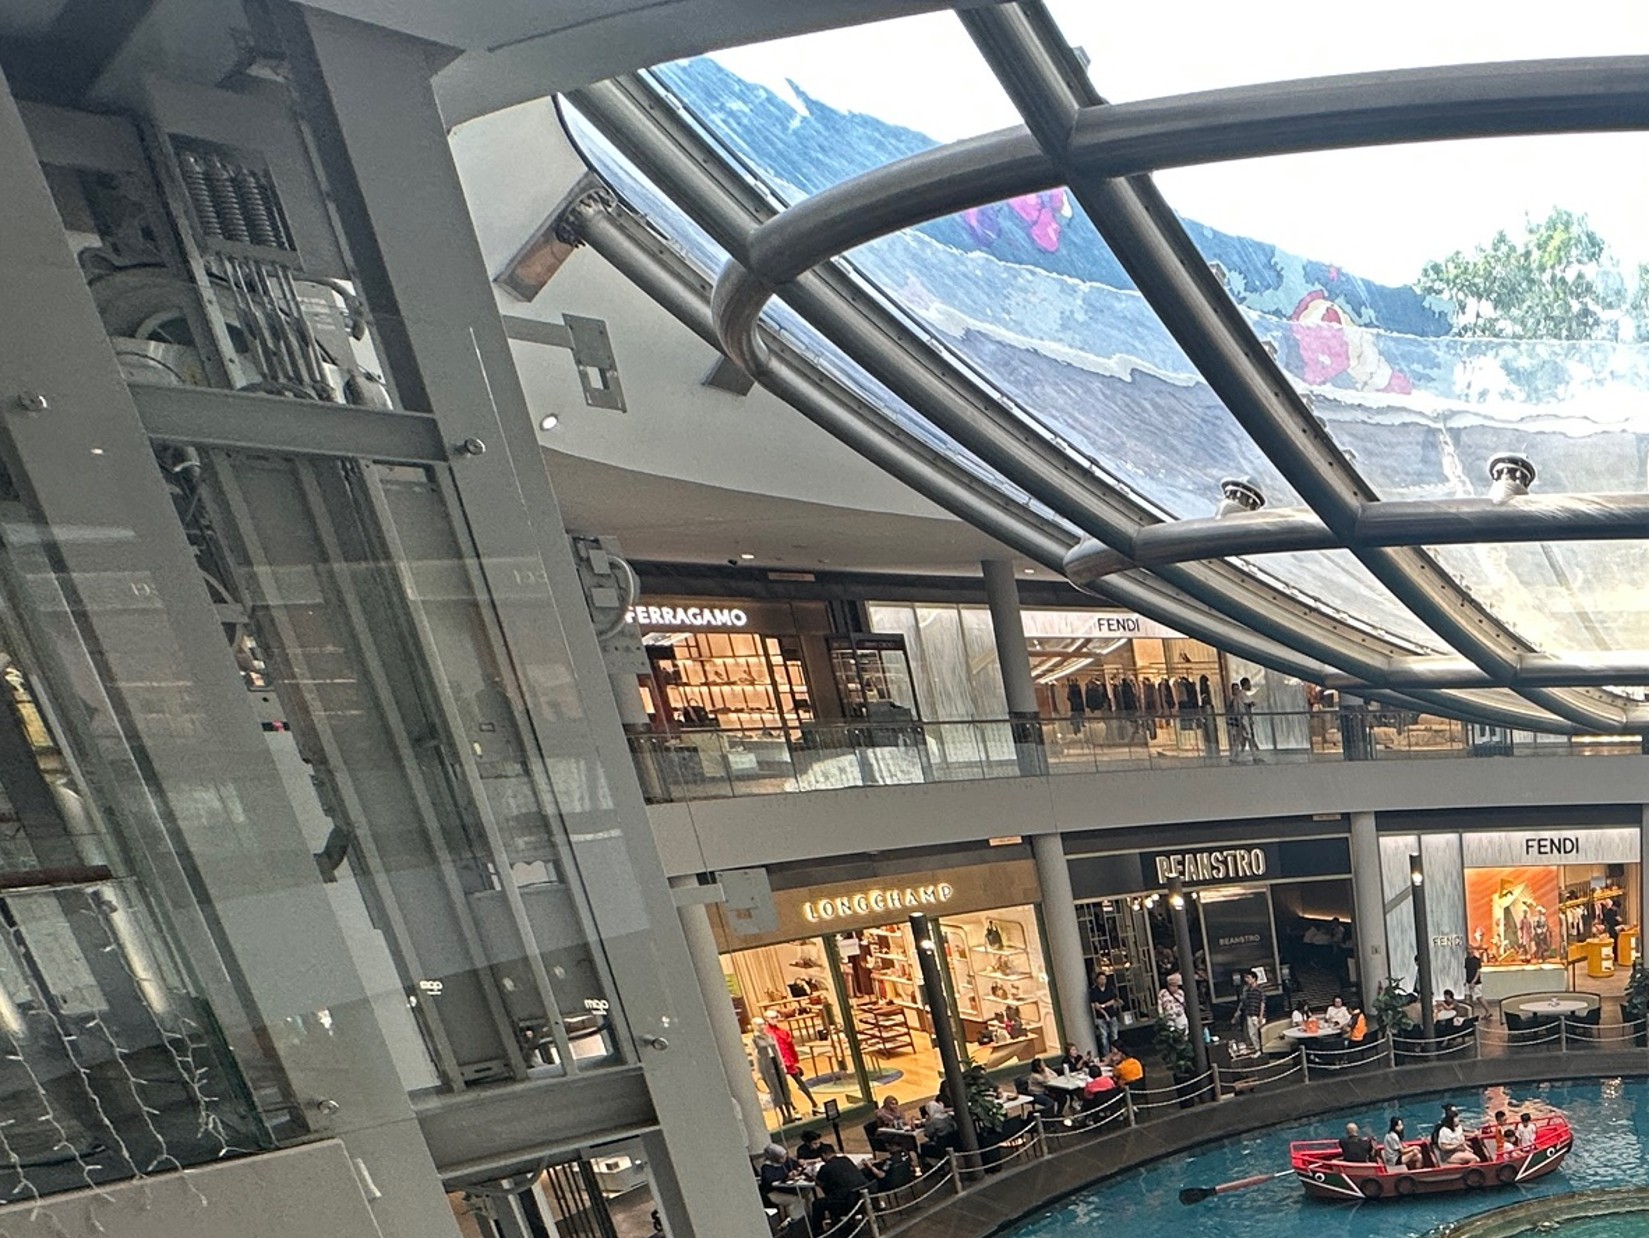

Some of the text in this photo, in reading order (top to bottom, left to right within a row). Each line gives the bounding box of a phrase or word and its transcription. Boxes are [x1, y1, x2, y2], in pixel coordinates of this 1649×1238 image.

[625, 606, 747, 627] FERRAGAMO
[1097, 617, 1141, 632] FENDI
[1525, 837, 1580, 855] FENDI
[1155, 848, 1267, 884] BEANSTRO
[803, 882, 954, 923] LONGCHAMP
[1432, 935, 1464, 948] FENDI
